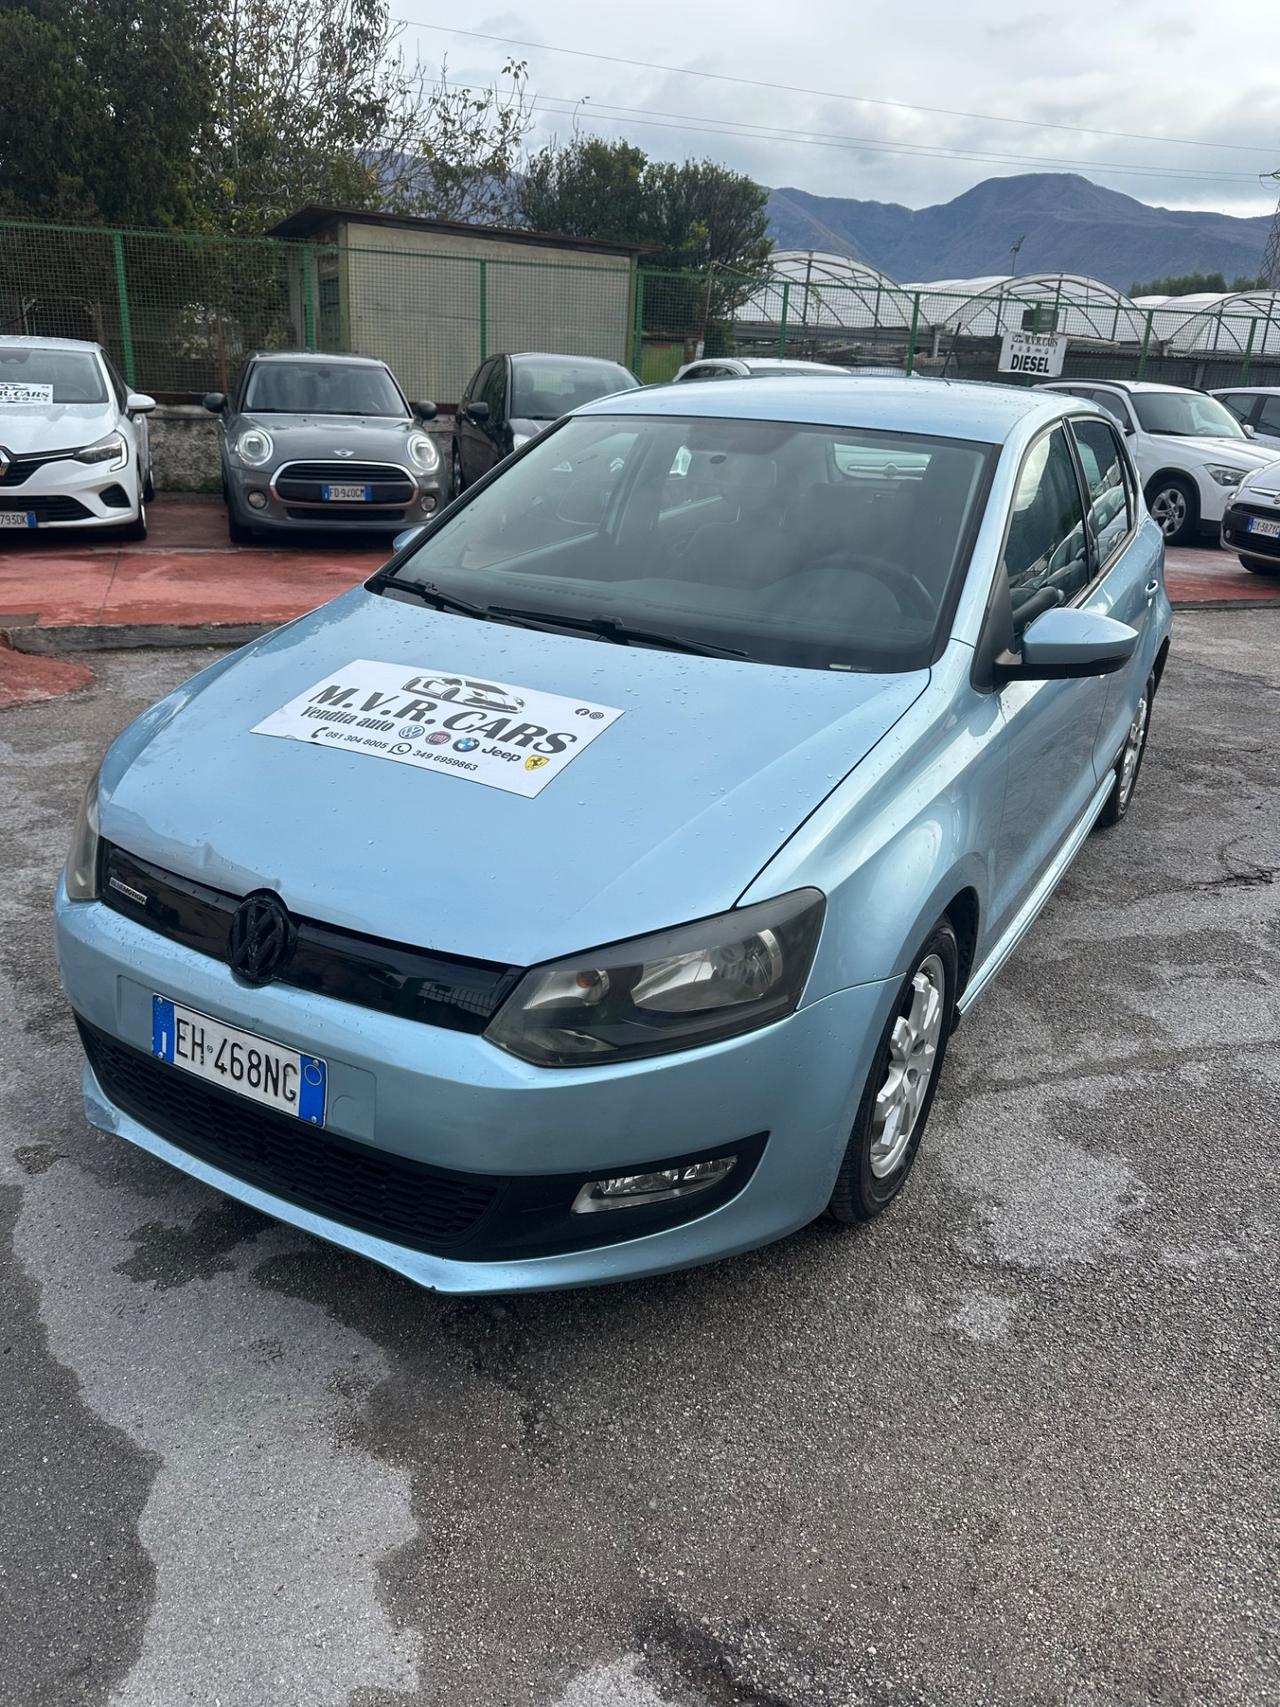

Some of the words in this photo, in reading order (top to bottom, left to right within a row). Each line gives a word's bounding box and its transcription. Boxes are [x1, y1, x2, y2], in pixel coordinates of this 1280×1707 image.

[1010, 354, 1049, 373] DIESEL
[300, 706, 358, 724] Vendita
[355, 717, 395, 731] auto
[325, 731, 344, 739] 081
[344, 735, 363, 743] 304
[363, 739, 389, 748] 8005
[413, 750, 432, 760] 349
[433, 755, 479, 771] 6959863
[482, 746, 521, 762] Jeep
